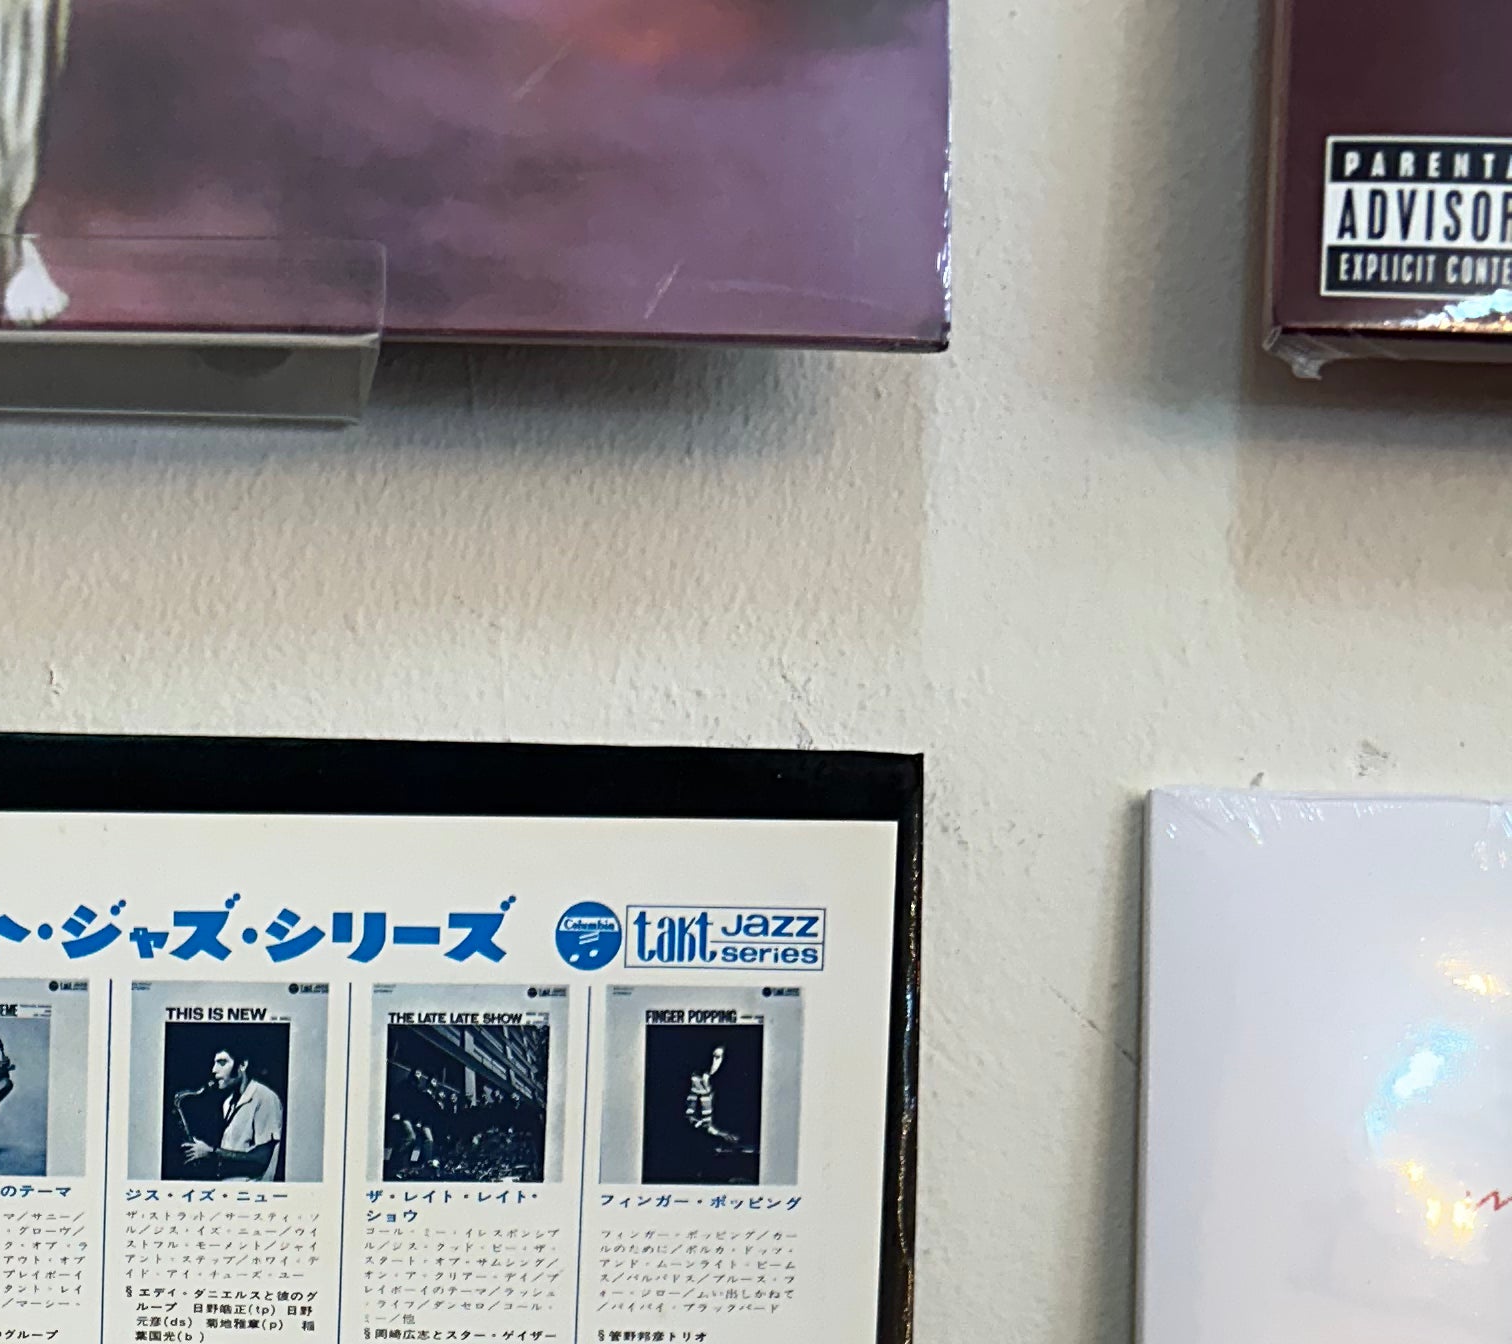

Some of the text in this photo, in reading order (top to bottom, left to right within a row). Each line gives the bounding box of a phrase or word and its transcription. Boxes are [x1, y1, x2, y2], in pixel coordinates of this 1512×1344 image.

[1338, 252, 1437, 283] EXPLICIT
[563, 915, 616, 932] Columbia
[720, 946, 820, 965] series
[165, 1006, 268, 1023] THIS IS NEW
[387, 1011, 523, 1026] THE LATE LATE SHOW
[645, 1009, 738, 1025] FINGER POPPING
